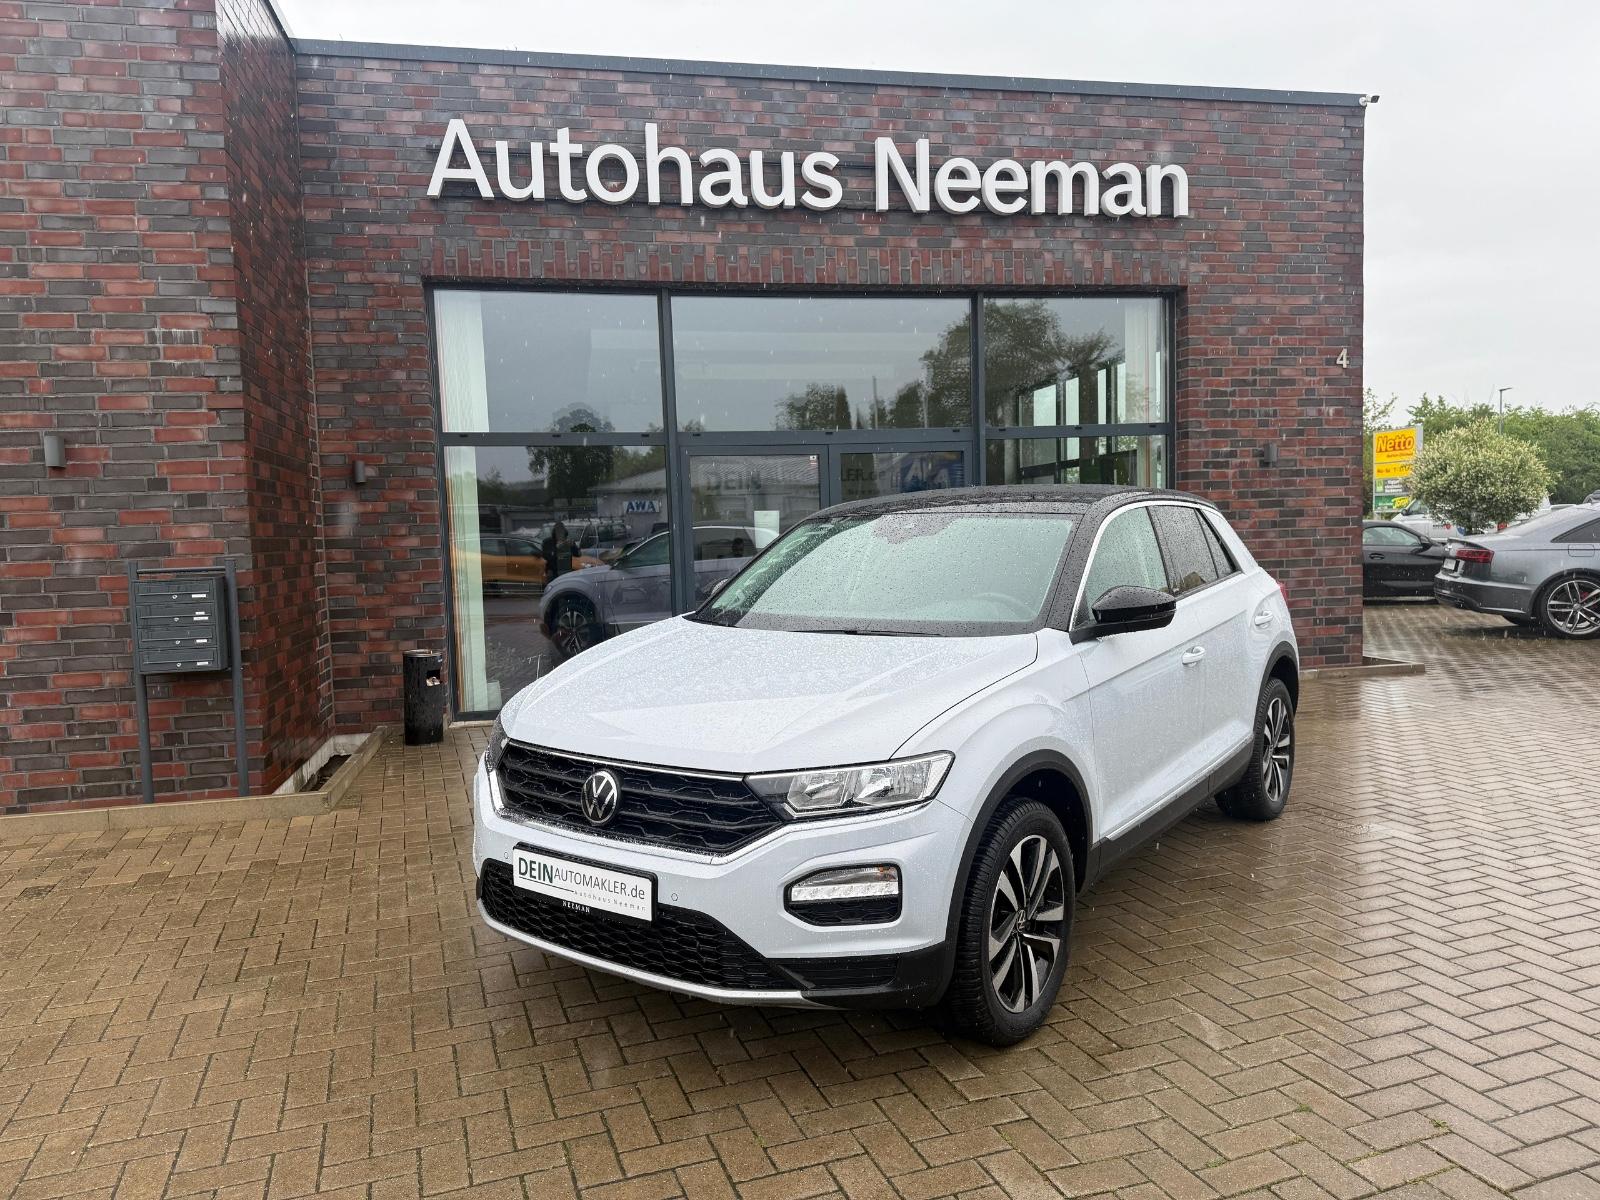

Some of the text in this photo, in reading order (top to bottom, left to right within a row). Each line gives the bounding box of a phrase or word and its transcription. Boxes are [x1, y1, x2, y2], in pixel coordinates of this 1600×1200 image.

[426, 118, 1190, 218] Autohaus Neeman
[1336, 347, 1350, 369] 4
[1376, 434, 1414, 453] Netto
[583, 773, 617, 821] VW
[562, 900, 591, 913] NEEMAN
